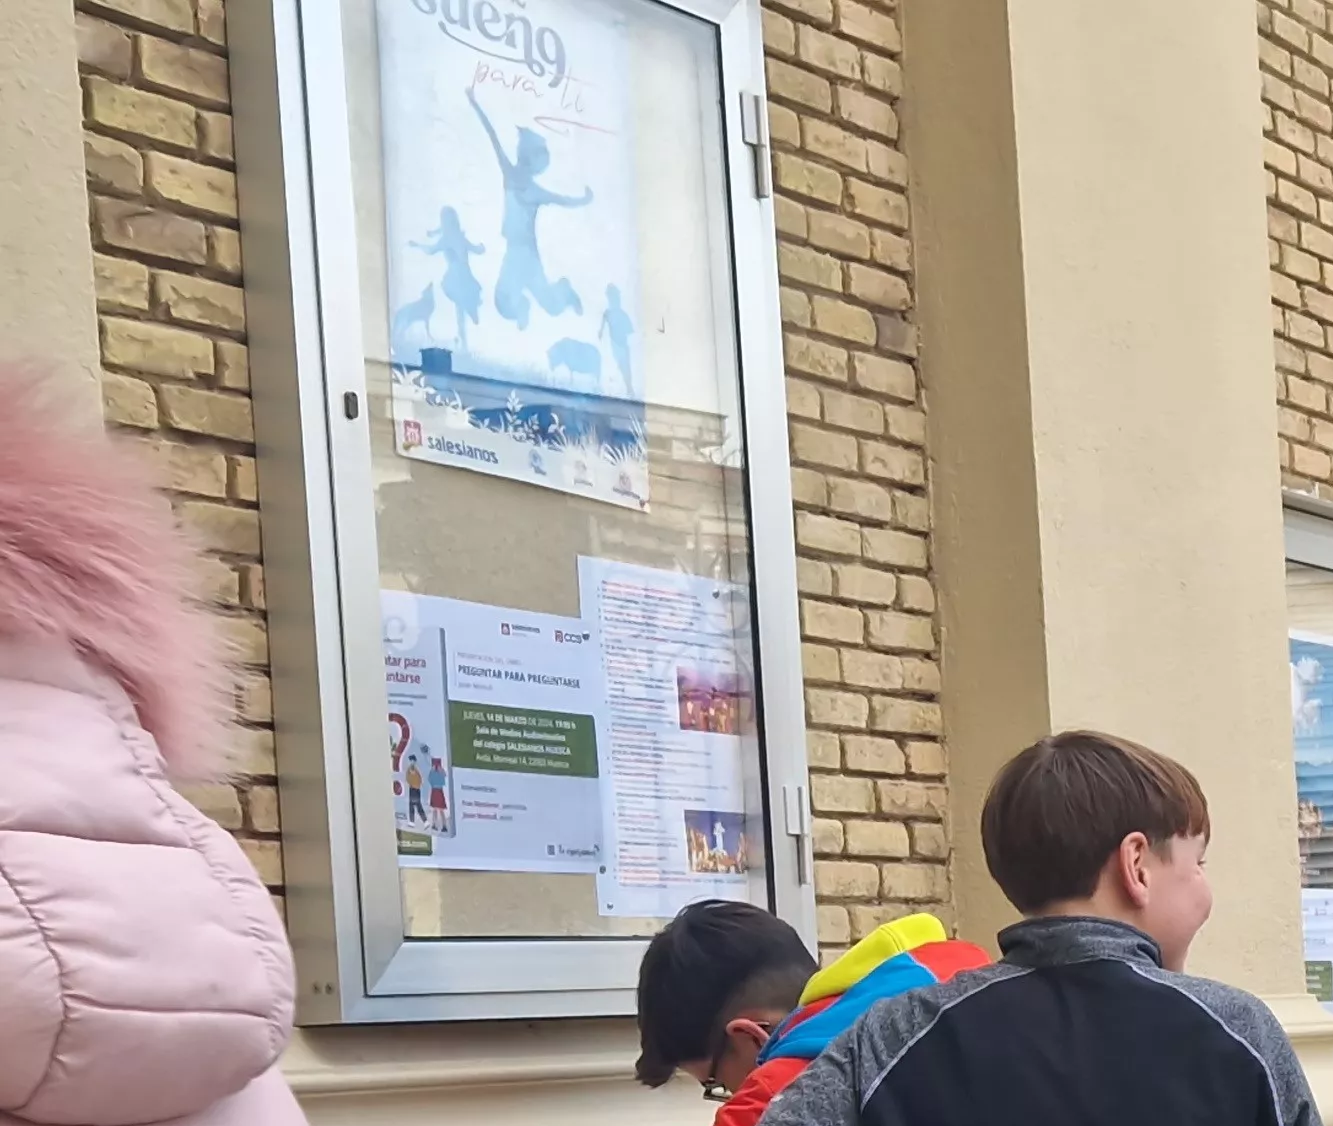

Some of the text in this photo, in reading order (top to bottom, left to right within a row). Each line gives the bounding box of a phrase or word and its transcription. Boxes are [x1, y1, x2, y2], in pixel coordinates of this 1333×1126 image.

[470, 61, 543, 98] para
[427, 435, 499, 465] salesianos
[404, 658, 427, 670] para
[504, 670, 526, 682] PARA
